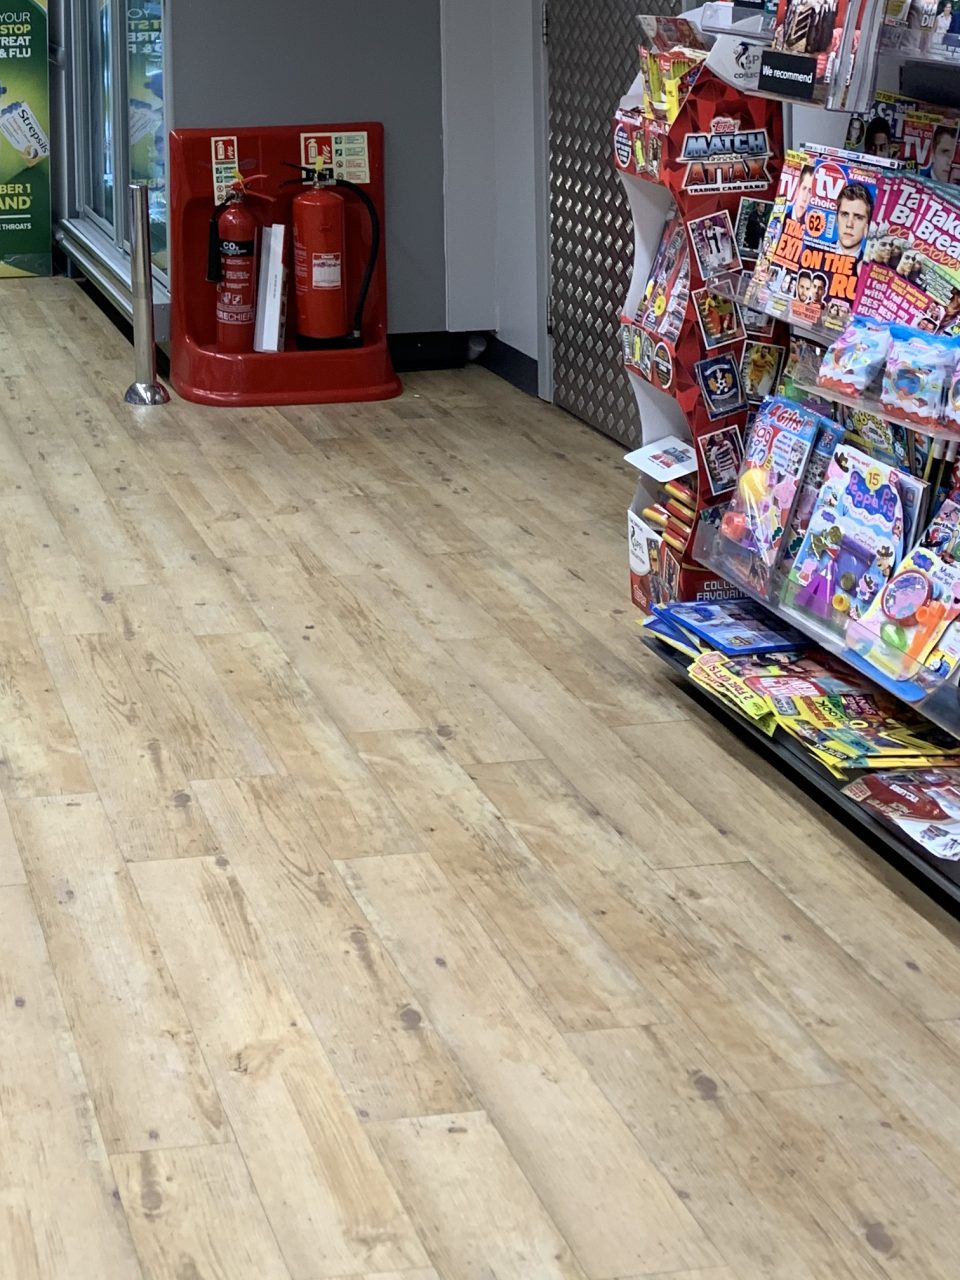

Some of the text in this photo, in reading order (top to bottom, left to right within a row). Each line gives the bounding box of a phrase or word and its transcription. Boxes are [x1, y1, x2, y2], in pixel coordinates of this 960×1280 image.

[0, 23, 32, 35] STOP
[8, 47, 32, 59] FLU
[762, 65, 814, 84] We recommend
[18, 109, 49, 154] Strepsils
[684, 131, 768, 157] MATCH
[904, 135, 932, 164] TV
[685, 158, 771, 186] ATTAX
[815, 167, 845, 200] tv
[25, 183, 31, 194] 1
[690, 186, 721, 194] TRADING
[722, 184, 743, 192] CARD
[780, 173, 800, 201] TV
[810, 196, 838, 210] choic
[2, 222, 32, 231] THROATS
[775, 233, 802, 263] EXIT
[801, 249, 823, 270] ON
[824, 252, 856, 276] THE
[777, 408, 806, 434] Gifts!
[868, 472, 881, 486] 15
[849, 472, 879, 508] Peppa
[882, 488, 896, 516] Pig
[815, 699, 844, 720] LOOK
